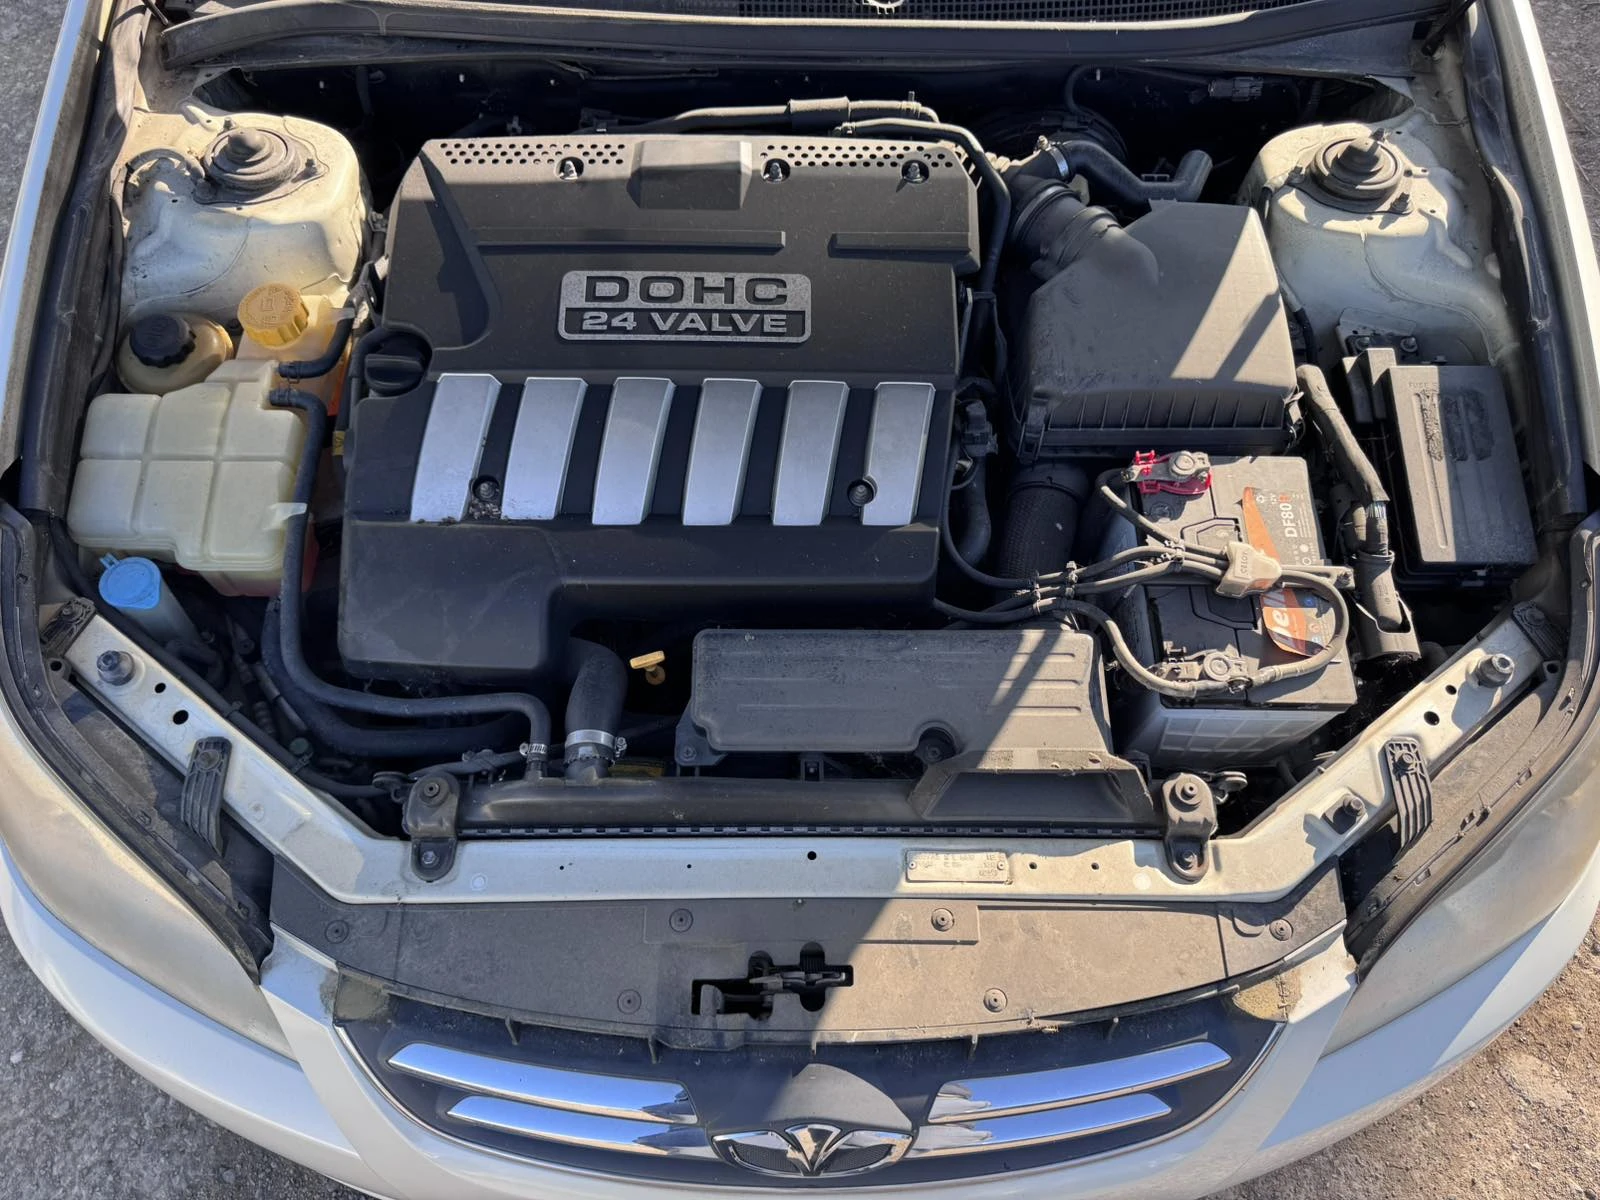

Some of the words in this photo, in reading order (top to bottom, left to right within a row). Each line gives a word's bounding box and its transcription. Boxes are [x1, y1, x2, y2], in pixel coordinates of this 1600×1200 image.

[586, 276, 787, 305] DOHC
[582, 311, 637, 330] 24
[650, 312, 787, 333] VALVE
